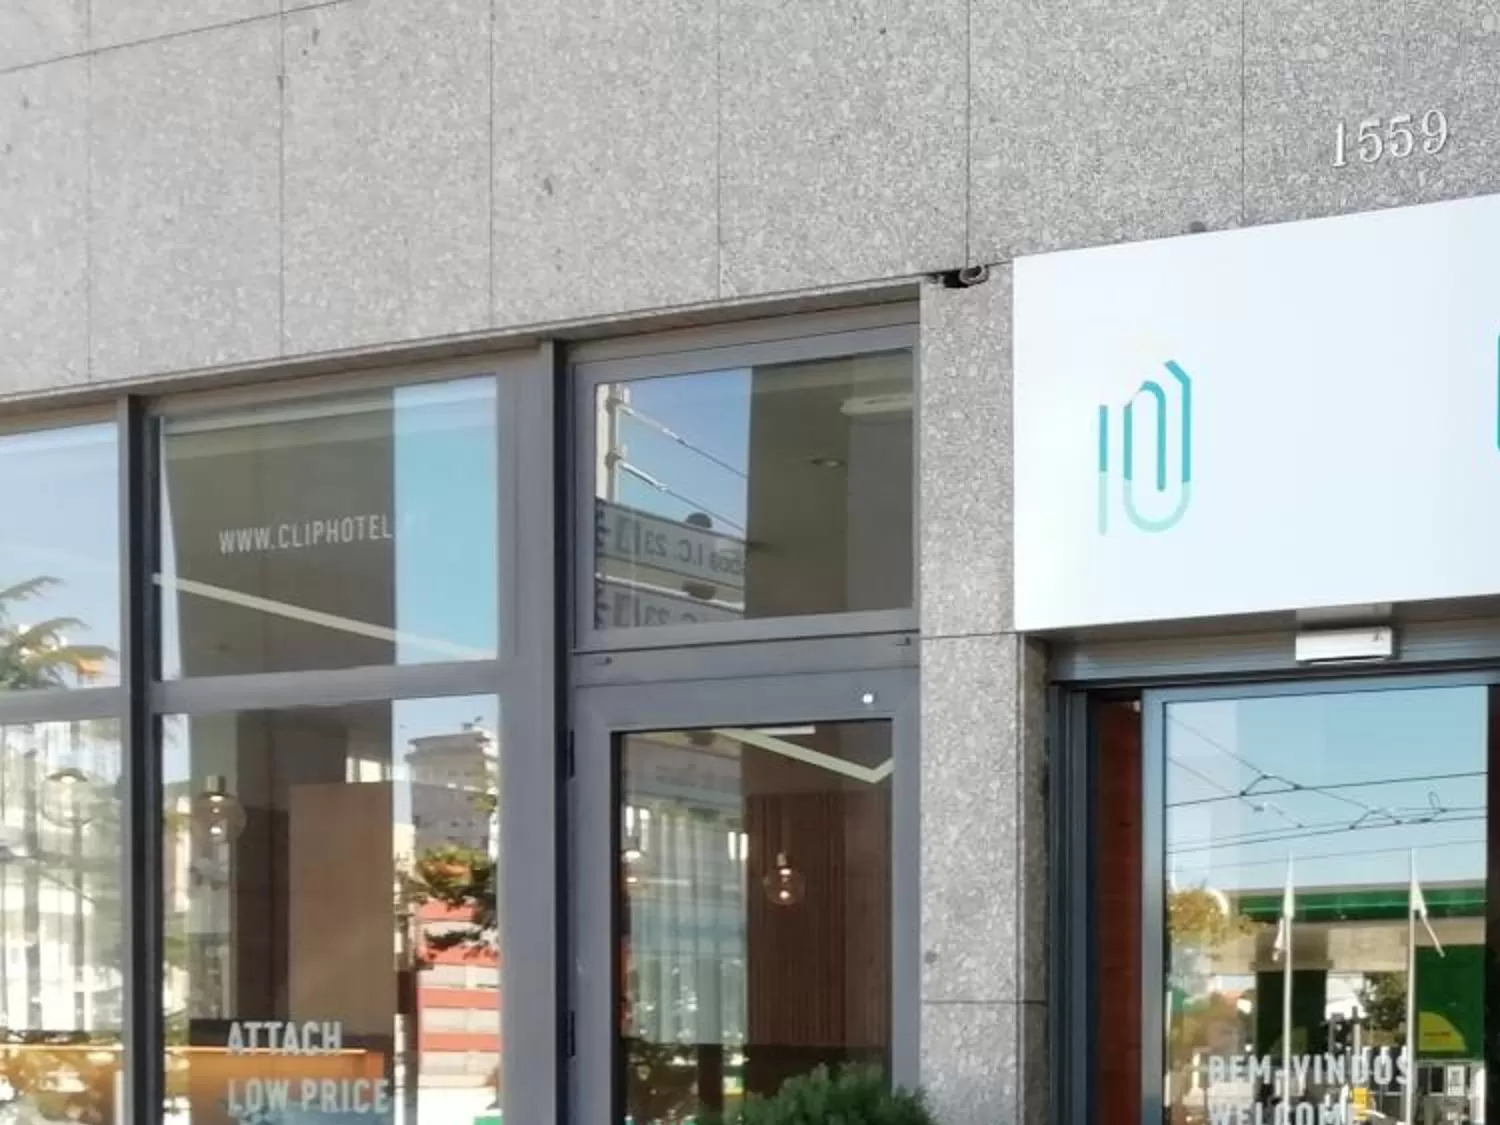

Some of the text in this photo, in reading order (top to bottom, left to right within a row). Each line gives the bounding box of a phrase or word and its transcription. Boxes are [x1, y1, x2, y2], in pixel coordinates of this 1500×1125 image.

[1333, 109, 1449, 169] 1559
[227, 1020, 343, 1057] ATTACH
[227, 1077, 290, 1116] LOW
